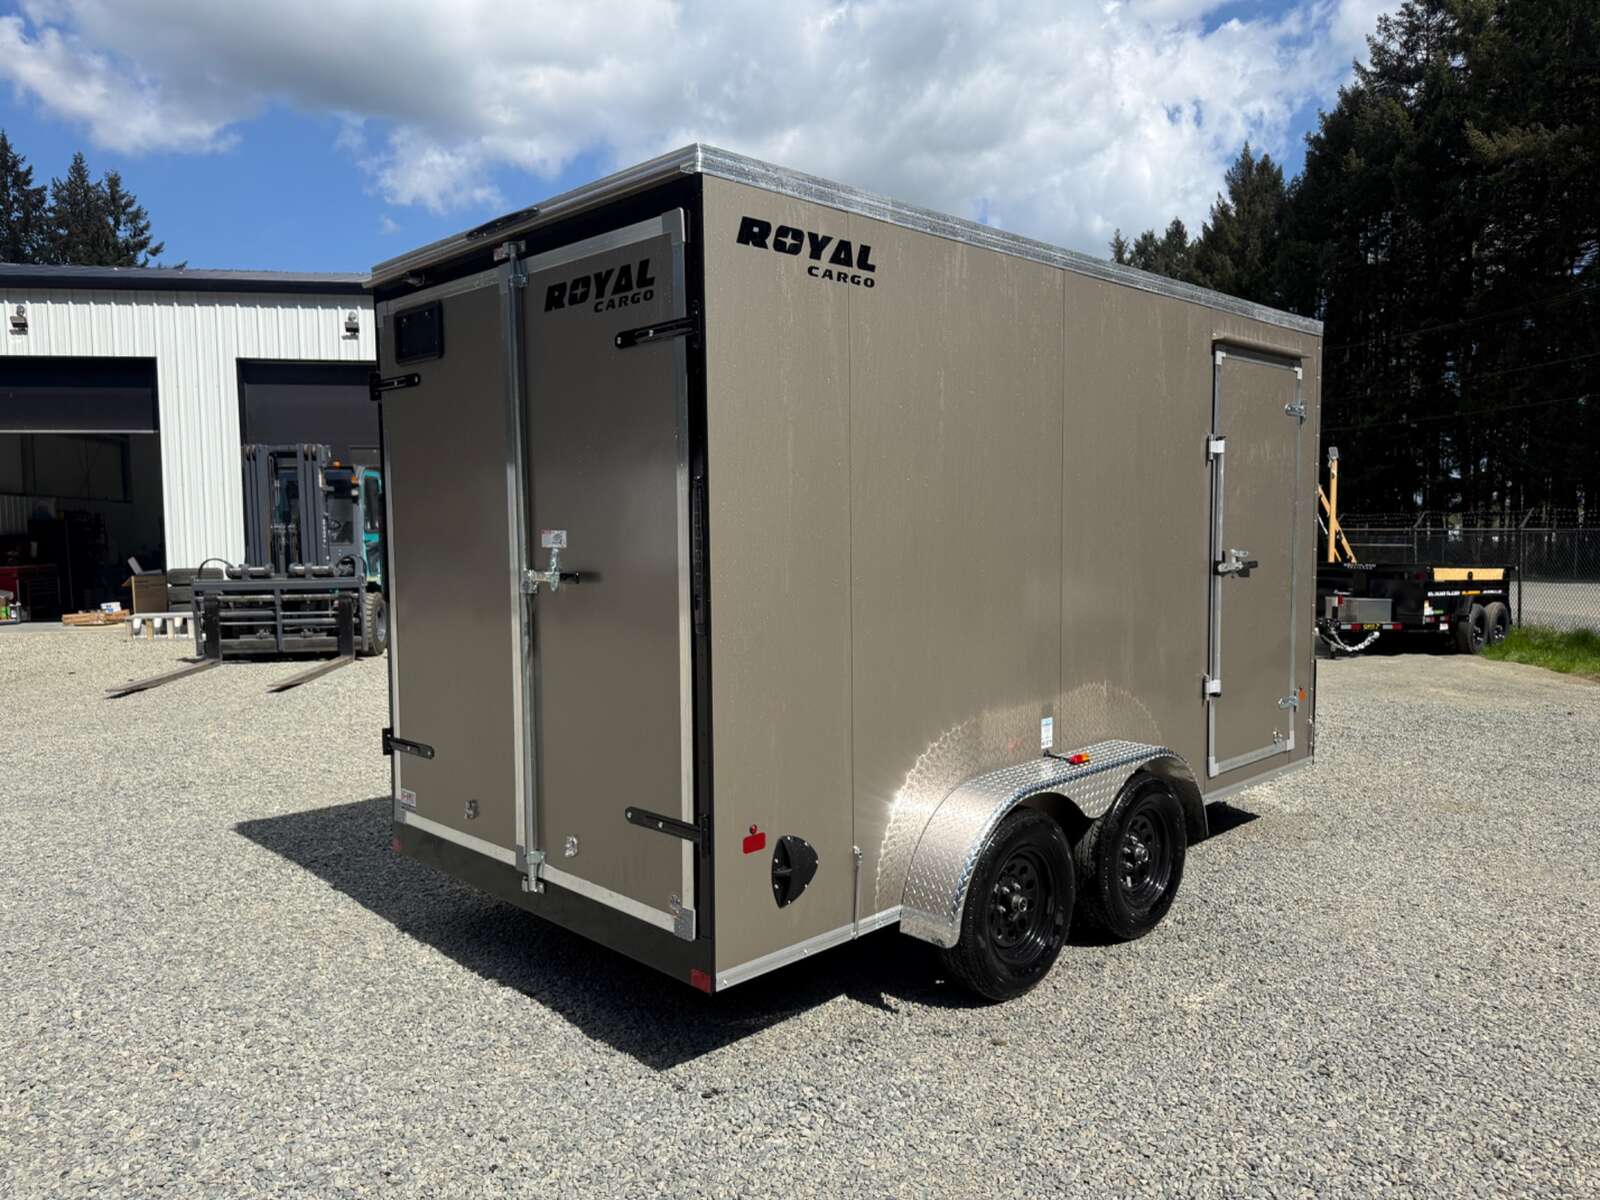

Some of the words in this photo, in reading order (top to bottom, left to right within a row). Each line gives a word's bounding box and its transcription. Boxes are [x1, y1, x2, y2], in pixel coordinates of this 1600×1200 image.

[736, 216, 876, 273] ROYAL
[544, 258, 655, 312] ROYAL
[807, 265, 875, 288] CARGO
[594, 289, 654, 313] CARGO
